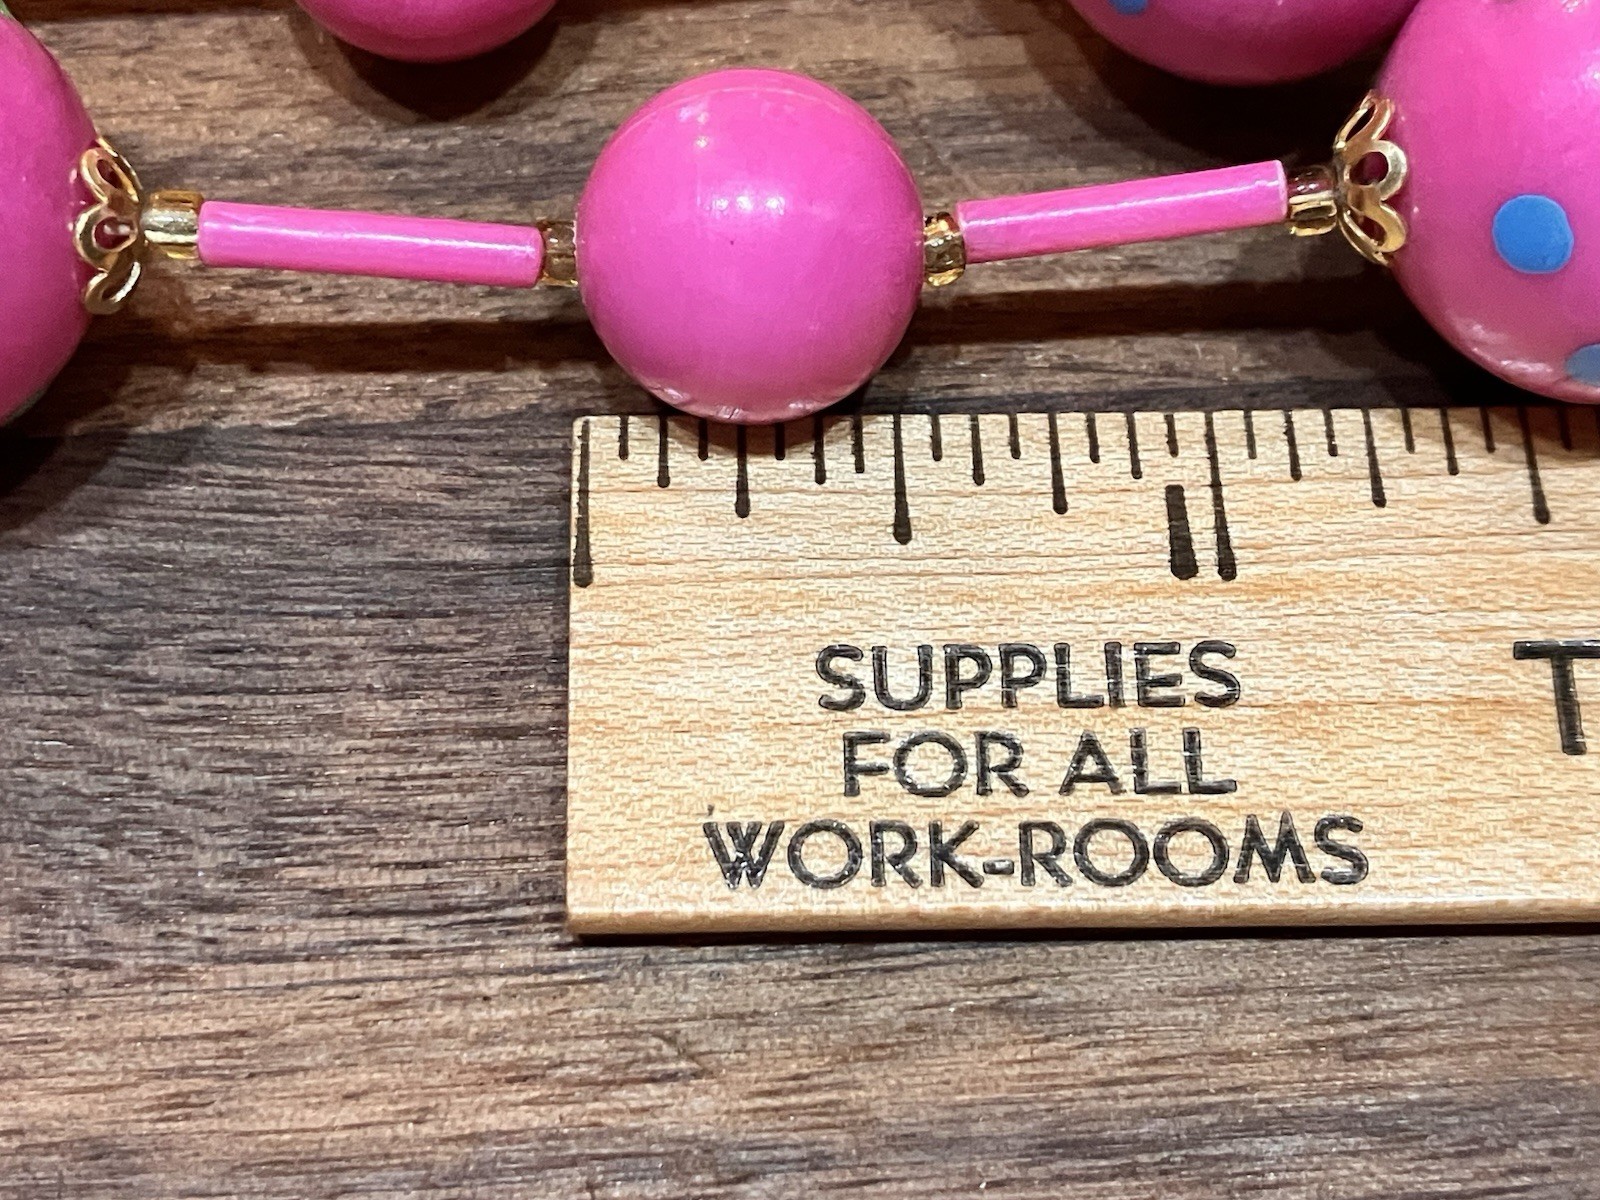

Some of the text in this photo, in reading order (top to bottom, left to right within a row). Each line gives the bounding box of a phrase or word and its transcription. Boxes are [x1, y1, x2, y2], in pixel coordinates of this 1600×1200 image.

[816, 640, 1241, 712] SUPPLIES
[843, 730, 1238, 798] FOR ALL
[703, 814, 1369, 890] WORK-ROOMS
